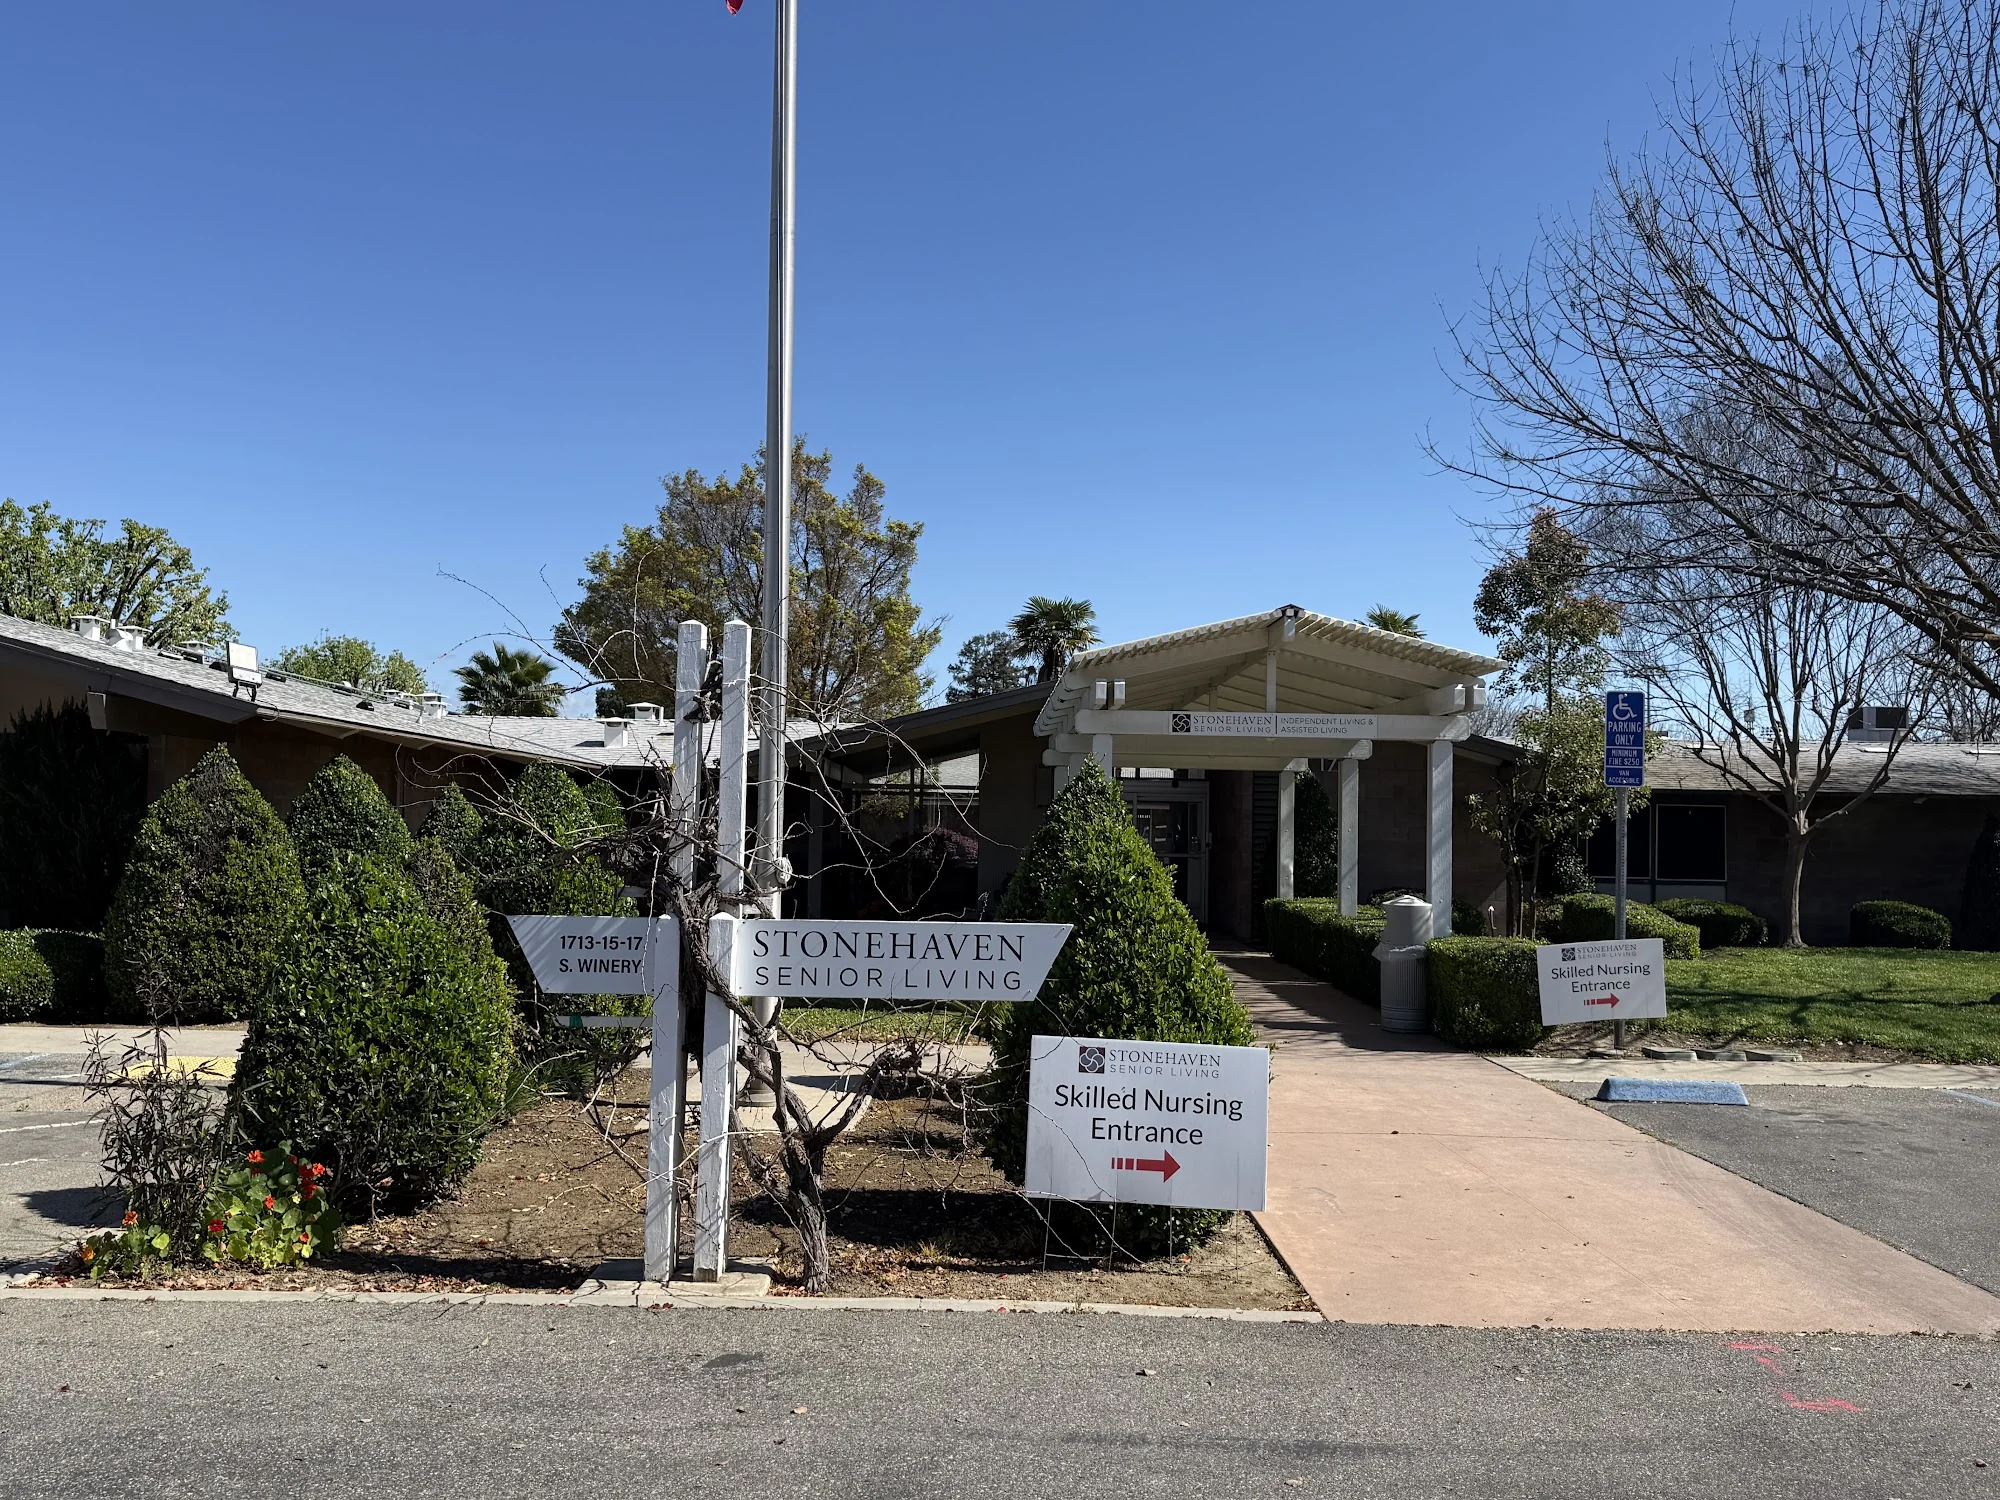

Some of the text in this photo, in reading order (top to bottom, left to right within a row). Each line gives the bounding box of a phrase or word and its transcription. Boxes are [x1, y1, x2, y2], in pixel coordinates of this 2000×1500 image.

[1192, 715, 1272, 726] STONEHAVEN
[1280, 718, 1338, 726] INDEPENDENT
[1608, 721, 1642, 732] PARKING
[1615, 734, 1634, 746] ONLY
[1612, 750, 1637, 758] MINIMUM
[560, 936, 643, 950] 1713-15-17
[753, 929, 1025, 962] STONEHAVEN
[1576, 944, 1637, 954] STONEHAVEN
[559, 958, 642, 974] S. WINERY
[1551, 962, 1650, 980] Skilled Nursing
[755, 966, 1022, 990] SENIOR LIVING
[1572, 980, 1631, 993] Entrance
[1109, 1049, 1221, 1067] STONEHAVEN
[1110, 1064, 1220, 1078] SENIOR LIVING
[1054, 1084, 1244, 1122] Skilled Nursing
[1092, 1117, 1203, 1146] Entrance
